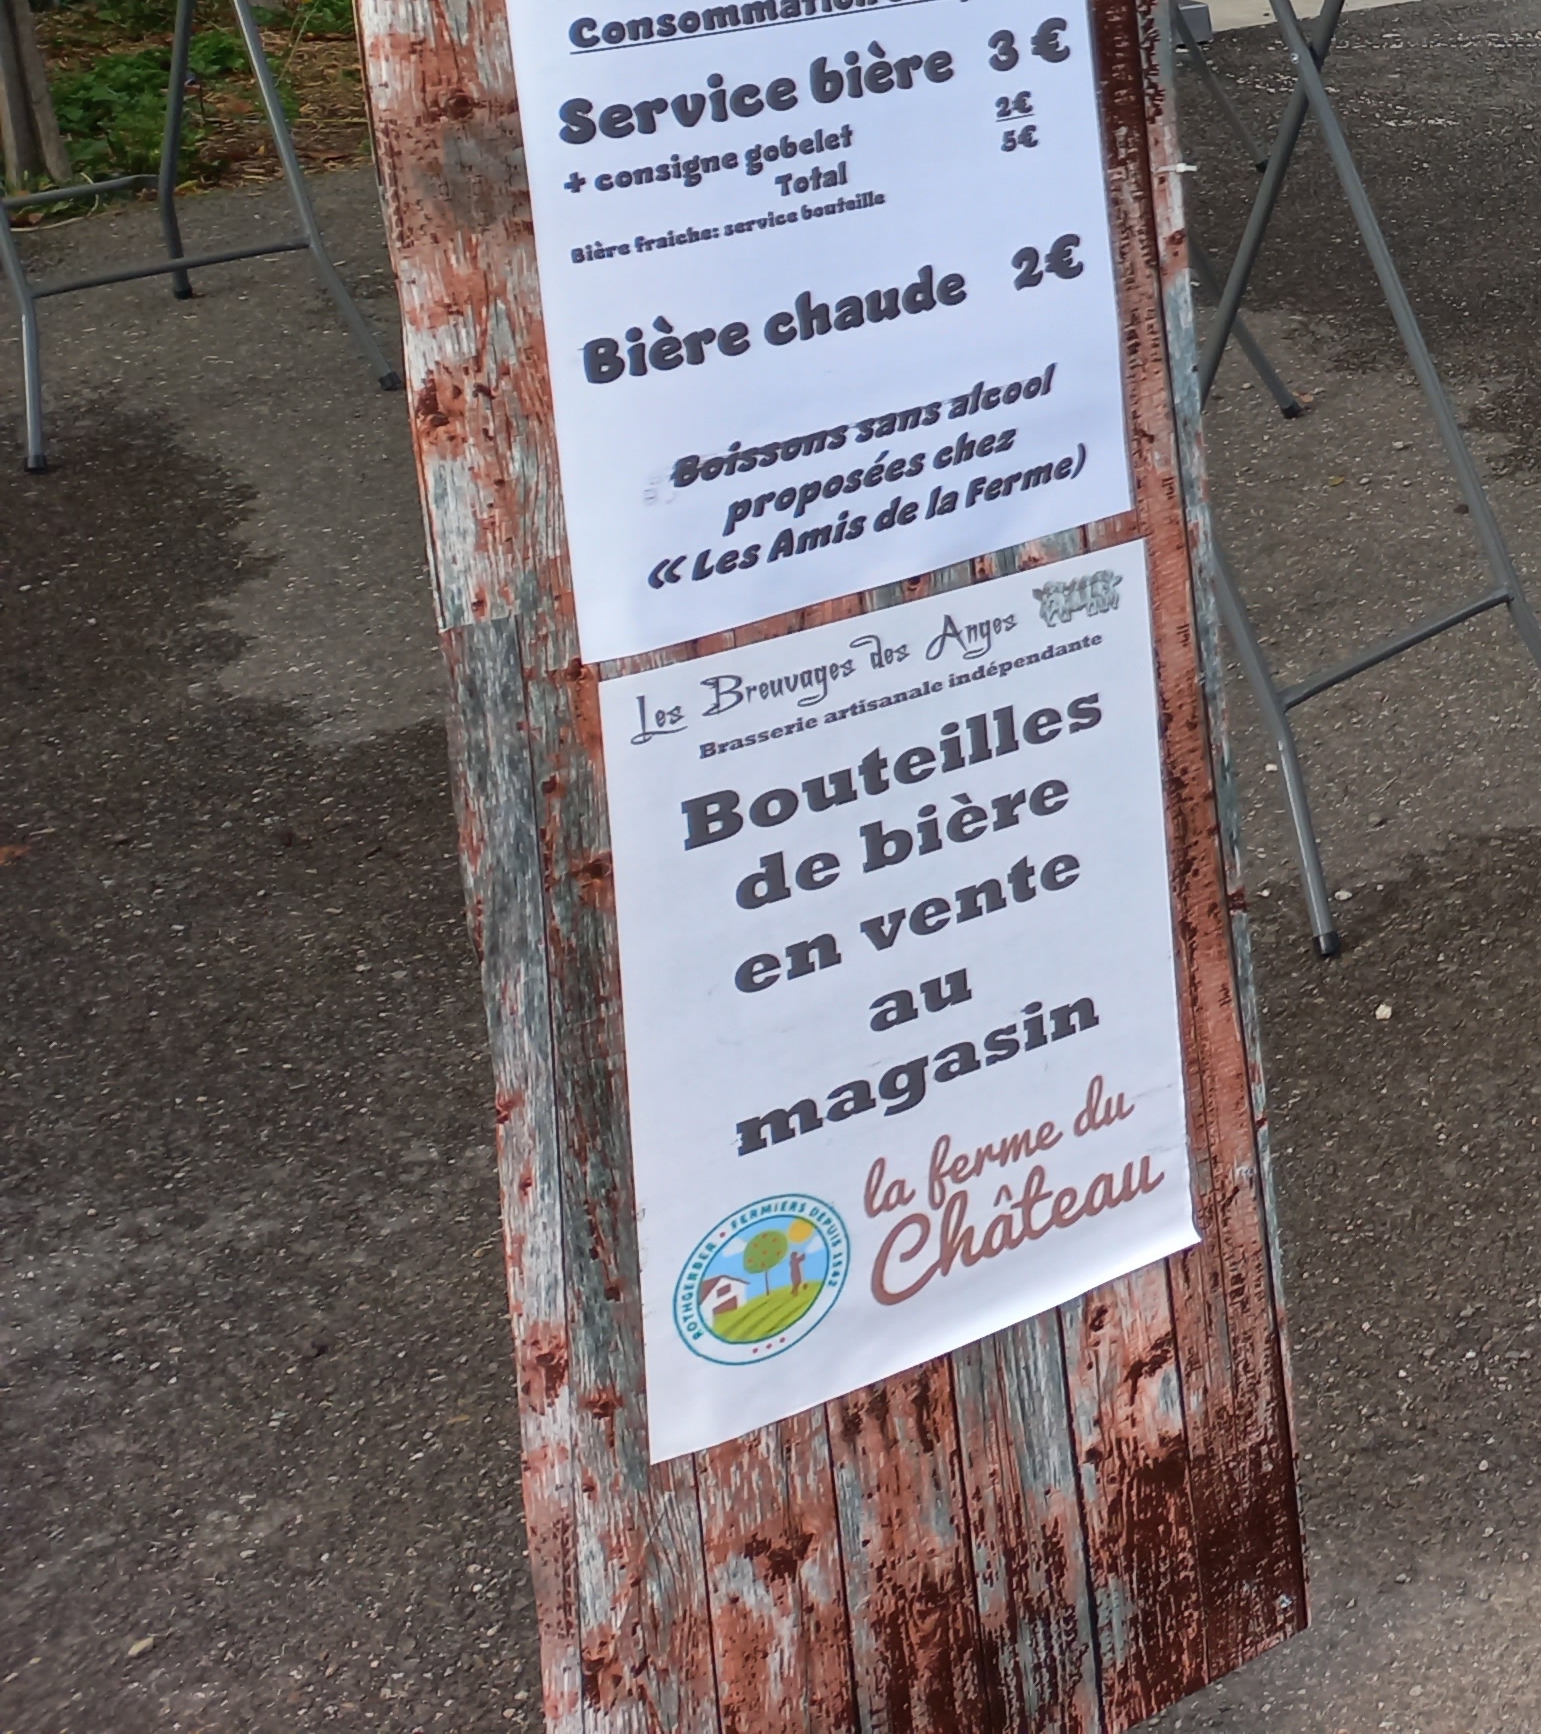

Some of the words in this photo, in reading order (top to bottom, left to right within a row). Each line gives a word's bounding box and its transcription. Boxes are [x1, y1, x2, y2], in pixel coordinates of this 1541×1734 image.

[558, 72, 797, 146] Service
[809, 41, 954, 105] bière
[988, 30, 1019, 72] 3
[1031, 17, 1070, 63] €
[595, 152, 739, 191] consigne
[745, 124, 853, 176] gobelet
[995, 91, 1033, 118] 2€
[570, 241, 631, 264] Bière
[635, 227, 719, 254] fraiche:
[724, 210, 798, 237] service
[800, 190, 885, 220] bouteille
[775, 161, 848, 196] Total
[1000, 126, 1038, 154] 5€
[582, 315, 750, 385] Bière
[764, 266, 967, 346] chaude
[1012, 233, 1084, 292] 2€
[700, 716, 818, 759] Brasserie
[823, 681, 944, 726] artisanale
[948, 631, 1103, 684] indépendante
[681, 690, 1104, 851] Bouteilles
[734, 849, 841, 911] de
[860, 776, 1070, 874] bière
[733, 931, 841, 995] en
[860, 851, 1081, 953] vente
[868, 966, 972, 1033] au
[736, 994, 1101, 1158] magasin
[864, 1156, 915, 1218] la
[927, 1127, 1063, 1208] ferme
[1073, 1073, 1136, 1146] du
[731, 1201, 806, 1230] FERMIERS
[871, 1153, 1165, 1307] Château
